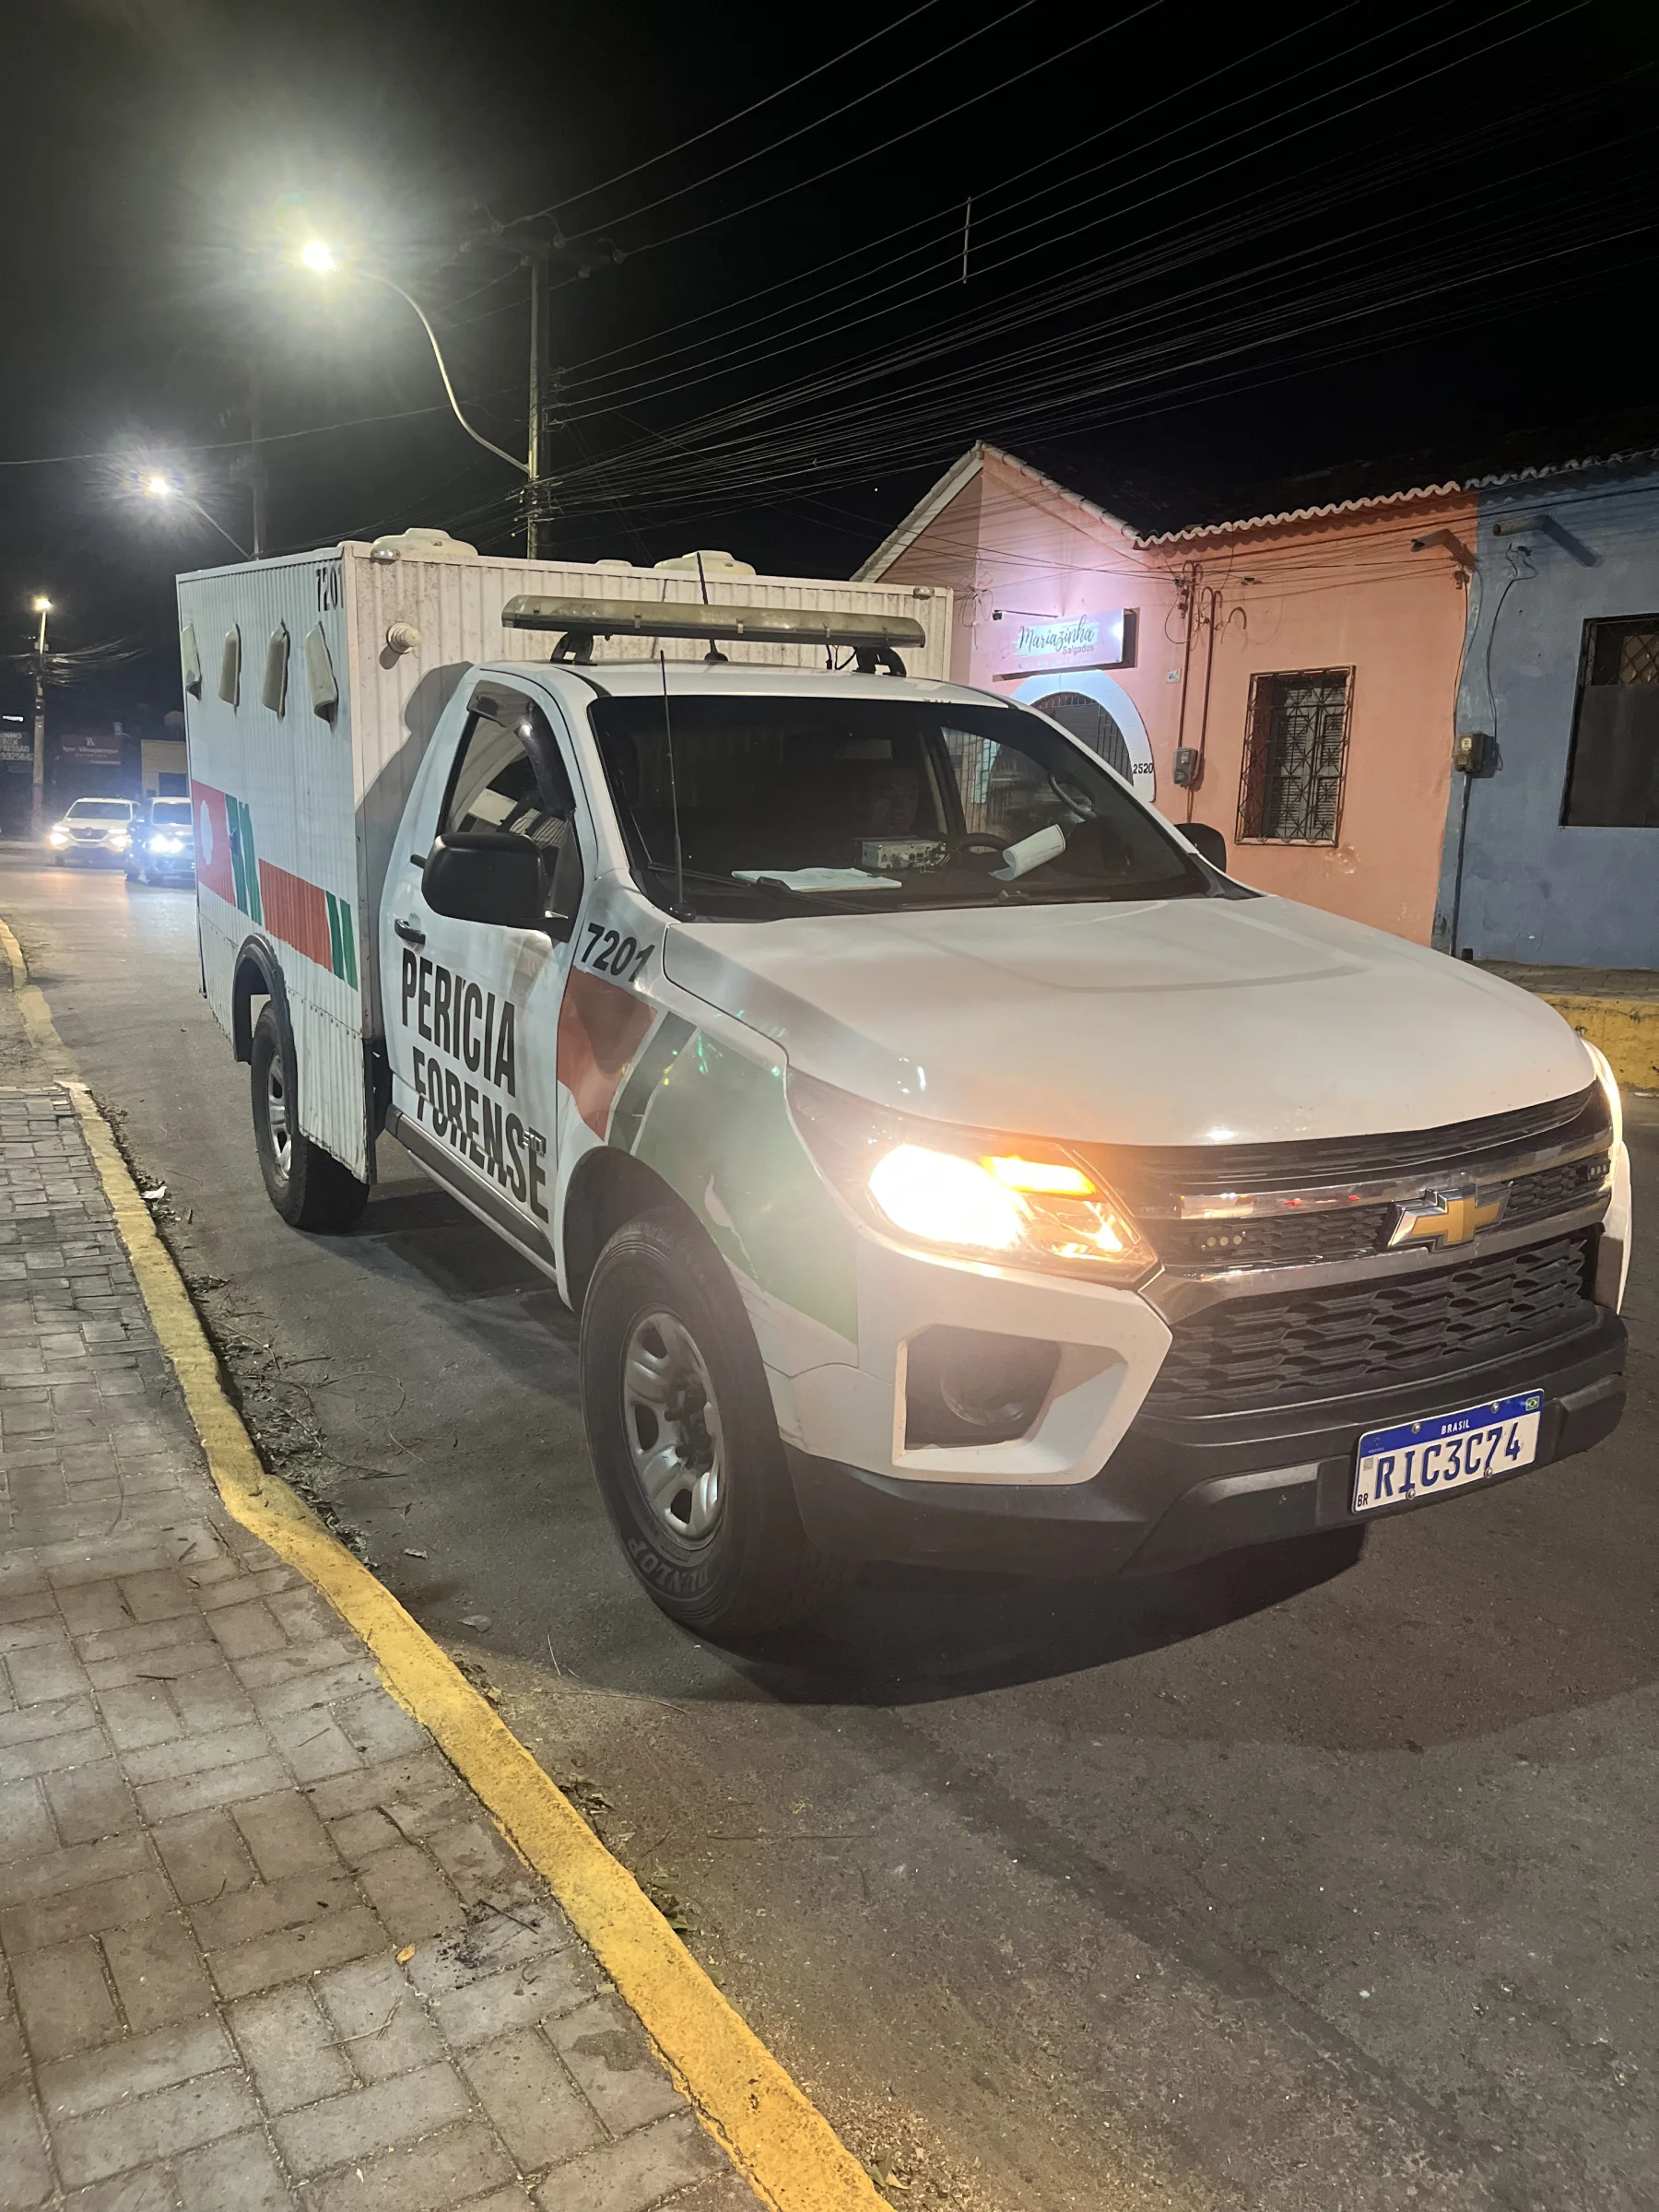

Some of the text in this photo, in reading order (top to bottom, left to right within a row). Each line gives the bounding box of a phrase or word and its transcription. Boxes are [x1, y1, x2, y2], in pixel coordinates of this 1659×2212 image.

[316, 563, 344, 612] 7201
[1018, 614, 1095, 653] Mariazinha
[1063, 643, 1095, 655] Salgados
[1133, 762, 1154, 774] 2520
[581, 923, 655, 983] 7201
[412, 1045, 549, 1225] FORENSE
[1441, 1418, 1470, 1435] BRASIL
[1374, 1422, 1519, 1500] RIC3C74
[1357, 1492, 1369, 1507] BR
